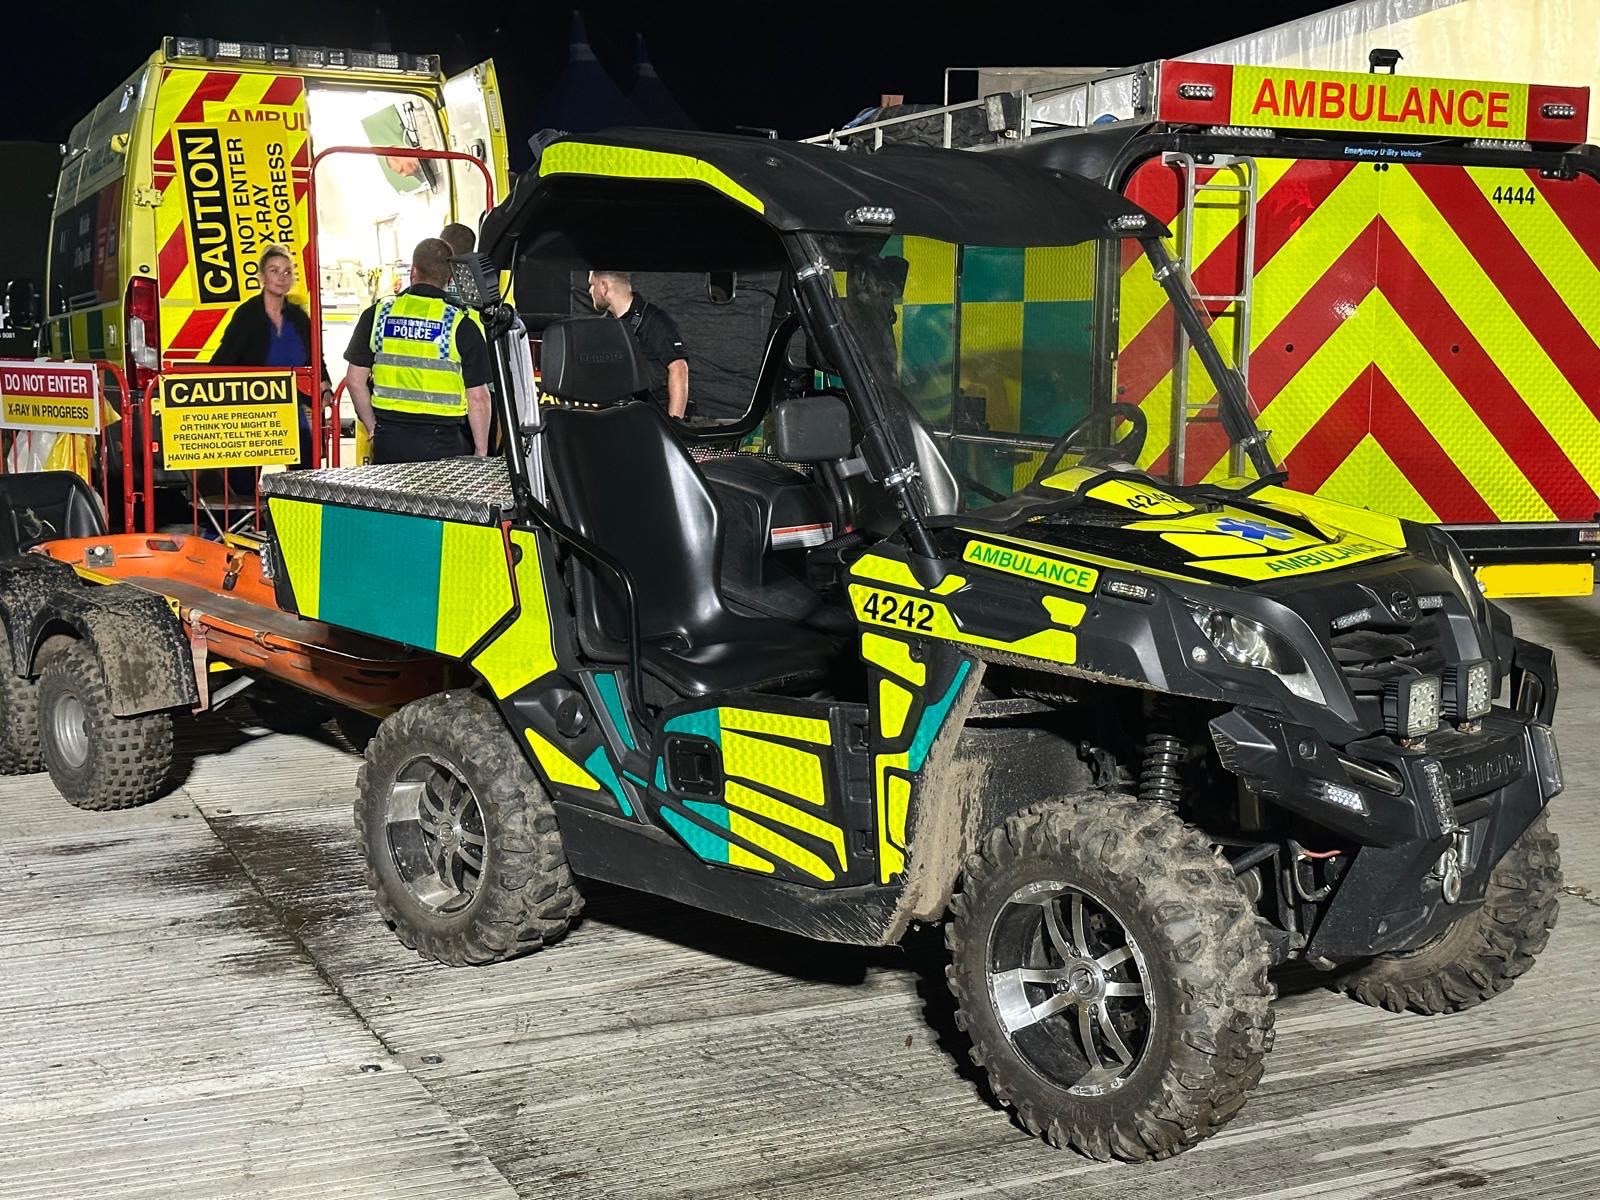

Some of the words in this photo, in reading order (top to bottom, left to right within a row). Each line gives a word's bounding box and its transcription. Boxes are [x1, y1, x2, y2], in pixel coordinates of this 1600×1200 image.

[1251, 78, 1510, 128] AMBULANCE
[1344, 146, 1378, 157] Emergency
[1400, 149, 1422, 157] Vehicle
[226, 138, 250, 206] ENTER
[1492, 186, 1535, 205] 4444
[185, 136, 233, 294] CAUTION
[252, 184, 275, 243] X-RAY
[236, 213, 257, 253] NOT
[242, 263, 261, 290] DO
[393, 325, 432, 339] POLICE
[4, 374, 20, 391] DO
[22, 374, 45, 392] NOT
[47, 375, 88, 393] ENTER
[170, 380, 287, 404] CAUTION
[8, 403, 30, 416] X-RAY
[31, 404, 40, 417] IN
[42, 405, 89, 420] PROGRESS
[191, 413, 209, 421] YOU
[211, 412, 229, 420] ARE
[231, 411, 277, 420] PREGNANT
[173, 433, 223, 441] PREGNANT,
[246, 430, 261, 438] THE
[264, 429, 288, 437] X-RAY
[180, 423, 193, 431] OR
[241, 421, 267, 429] MIGHT
[168, 453, 200, 461] HAVING
[244, 448, 296, 457] COMPLETED
[180, 440, 246, 451] TECHNOLOGIST
[249, 439, 283, 447] BEFORE
[969, 544, 1091, 588] AMBULANCE
[863, 592, 935, 632] 4242
